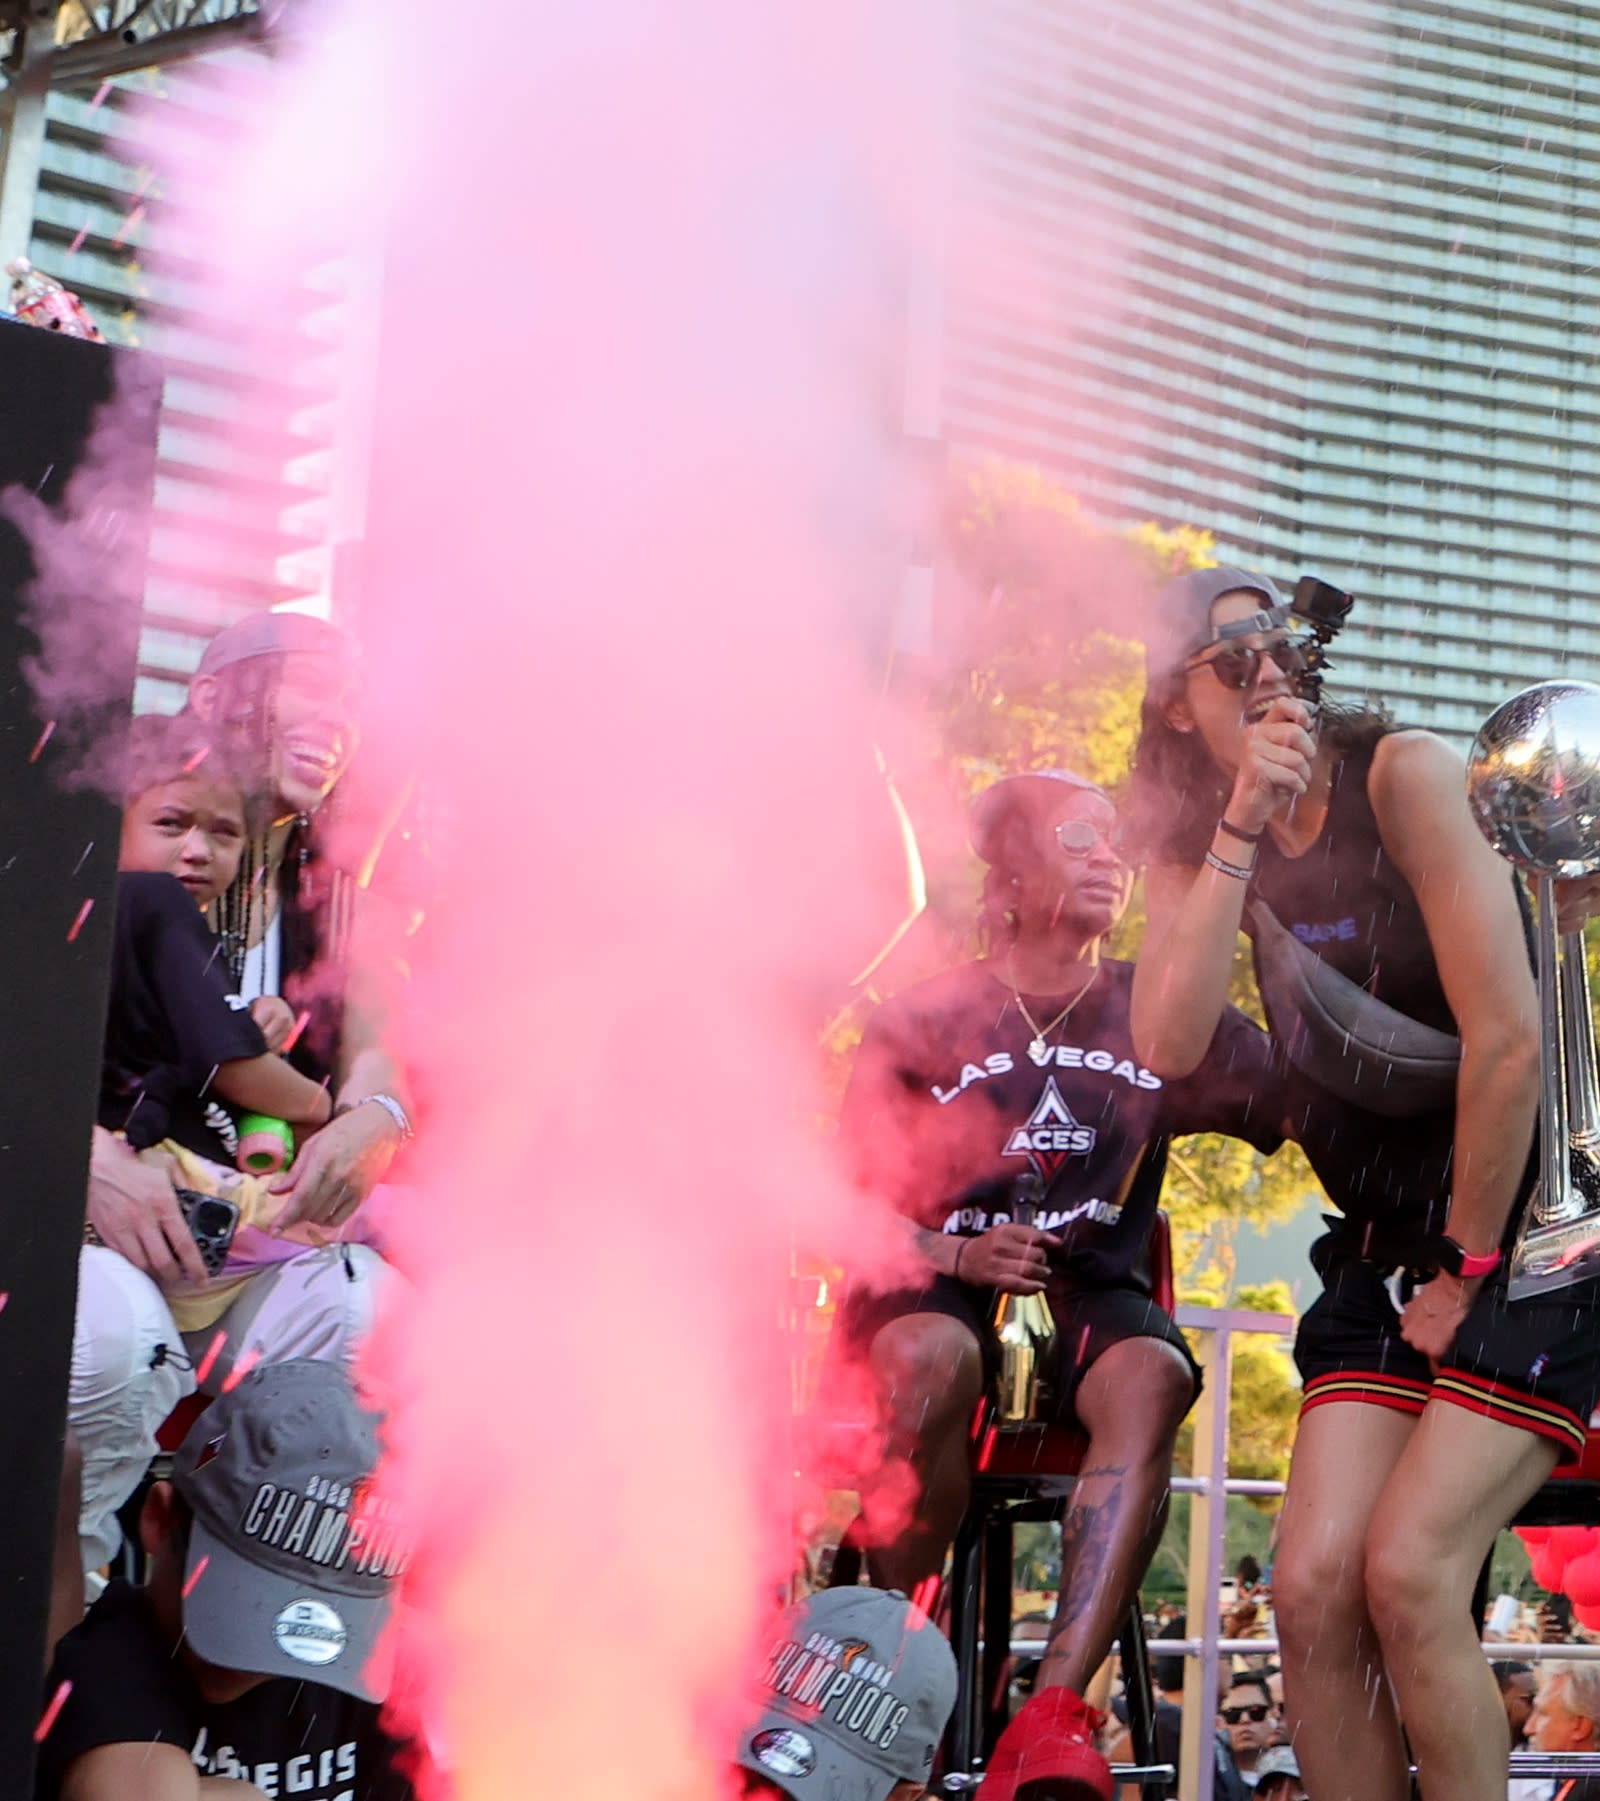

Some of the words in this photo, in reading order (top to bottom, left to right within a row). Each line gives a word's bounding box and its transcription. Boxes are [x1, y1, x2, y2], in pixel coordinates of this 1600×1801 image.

[931, 1052, 1014, 1104] LAS
[1028, 1046, 1163, 1090] VEGAS
[1011, 1131, 1090, 1150] ACES
